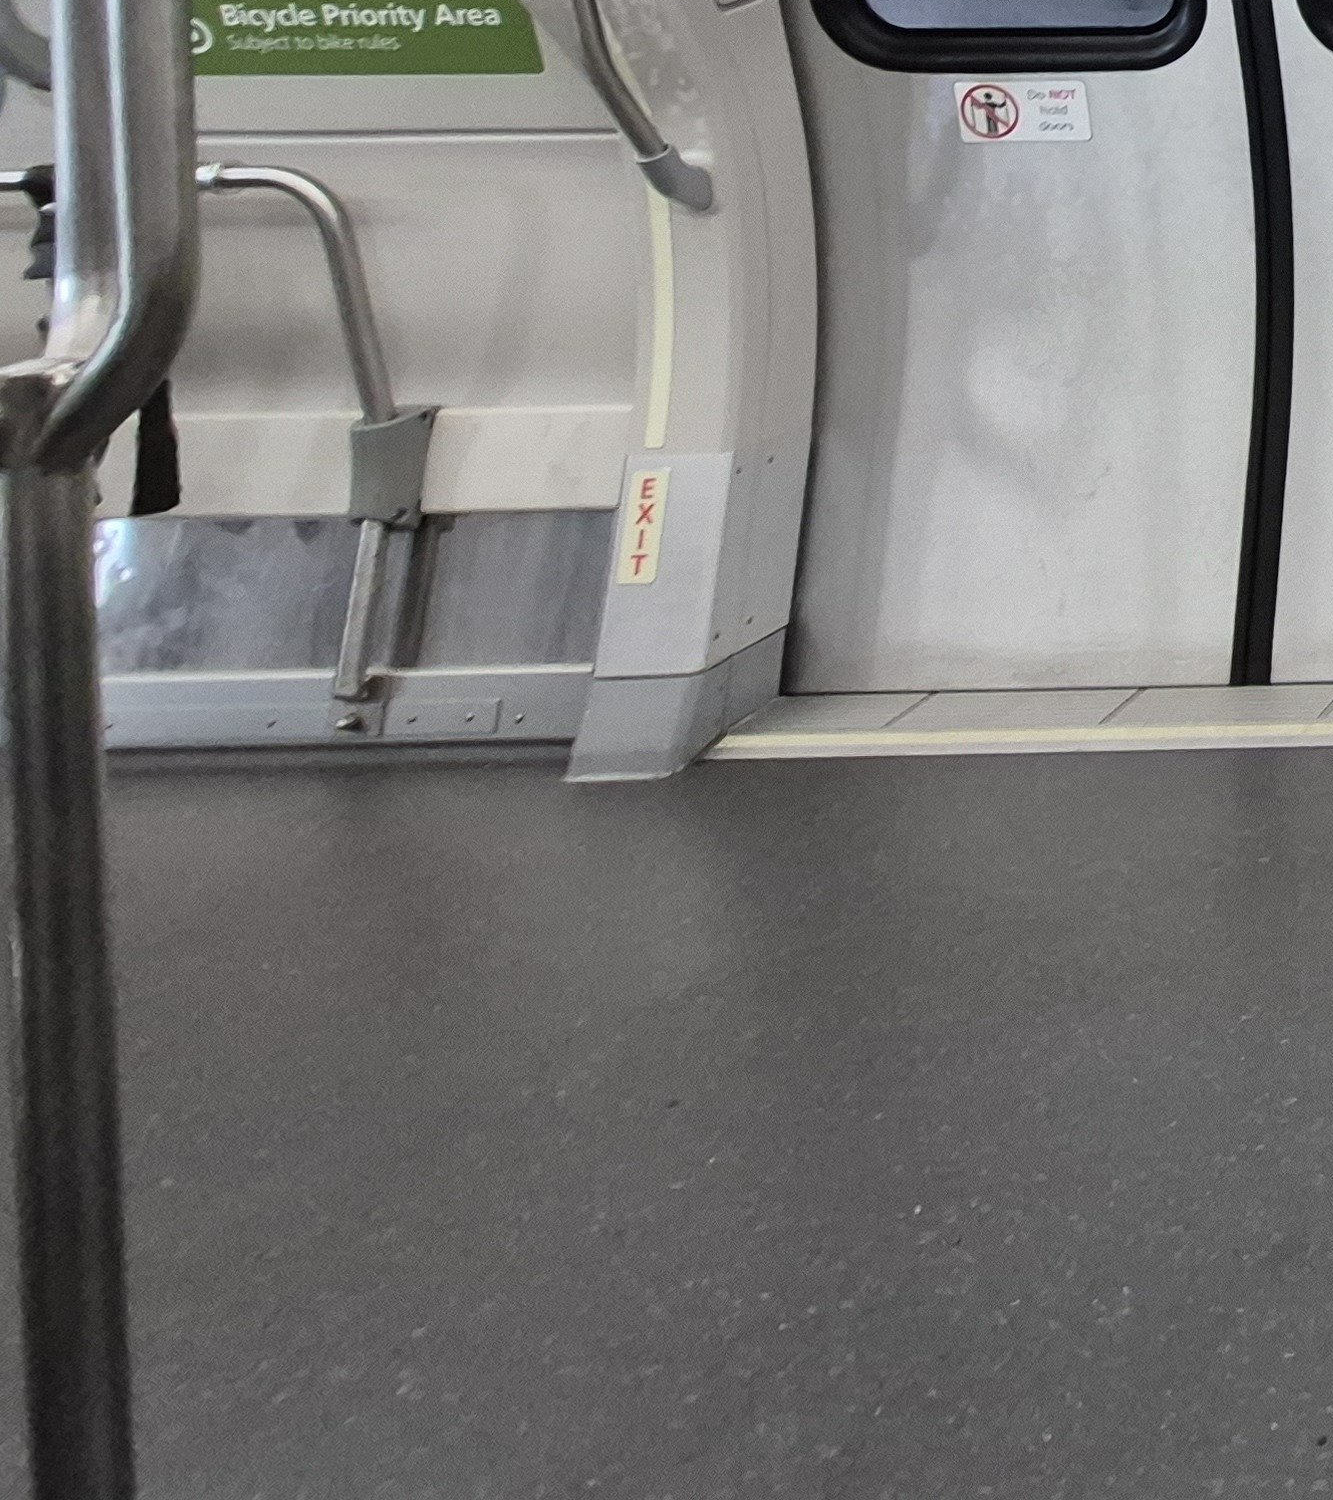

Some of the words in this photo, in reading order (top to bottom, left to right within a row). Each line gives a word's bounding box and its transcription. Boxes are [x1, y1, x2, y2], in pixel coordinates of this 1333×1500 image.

[219, 2, 318, 33] Bicycle
[320, 2, 426, 33] Priority
[434, 4, 502, 27] Area
[630, 477, 657, 577] EXIT
